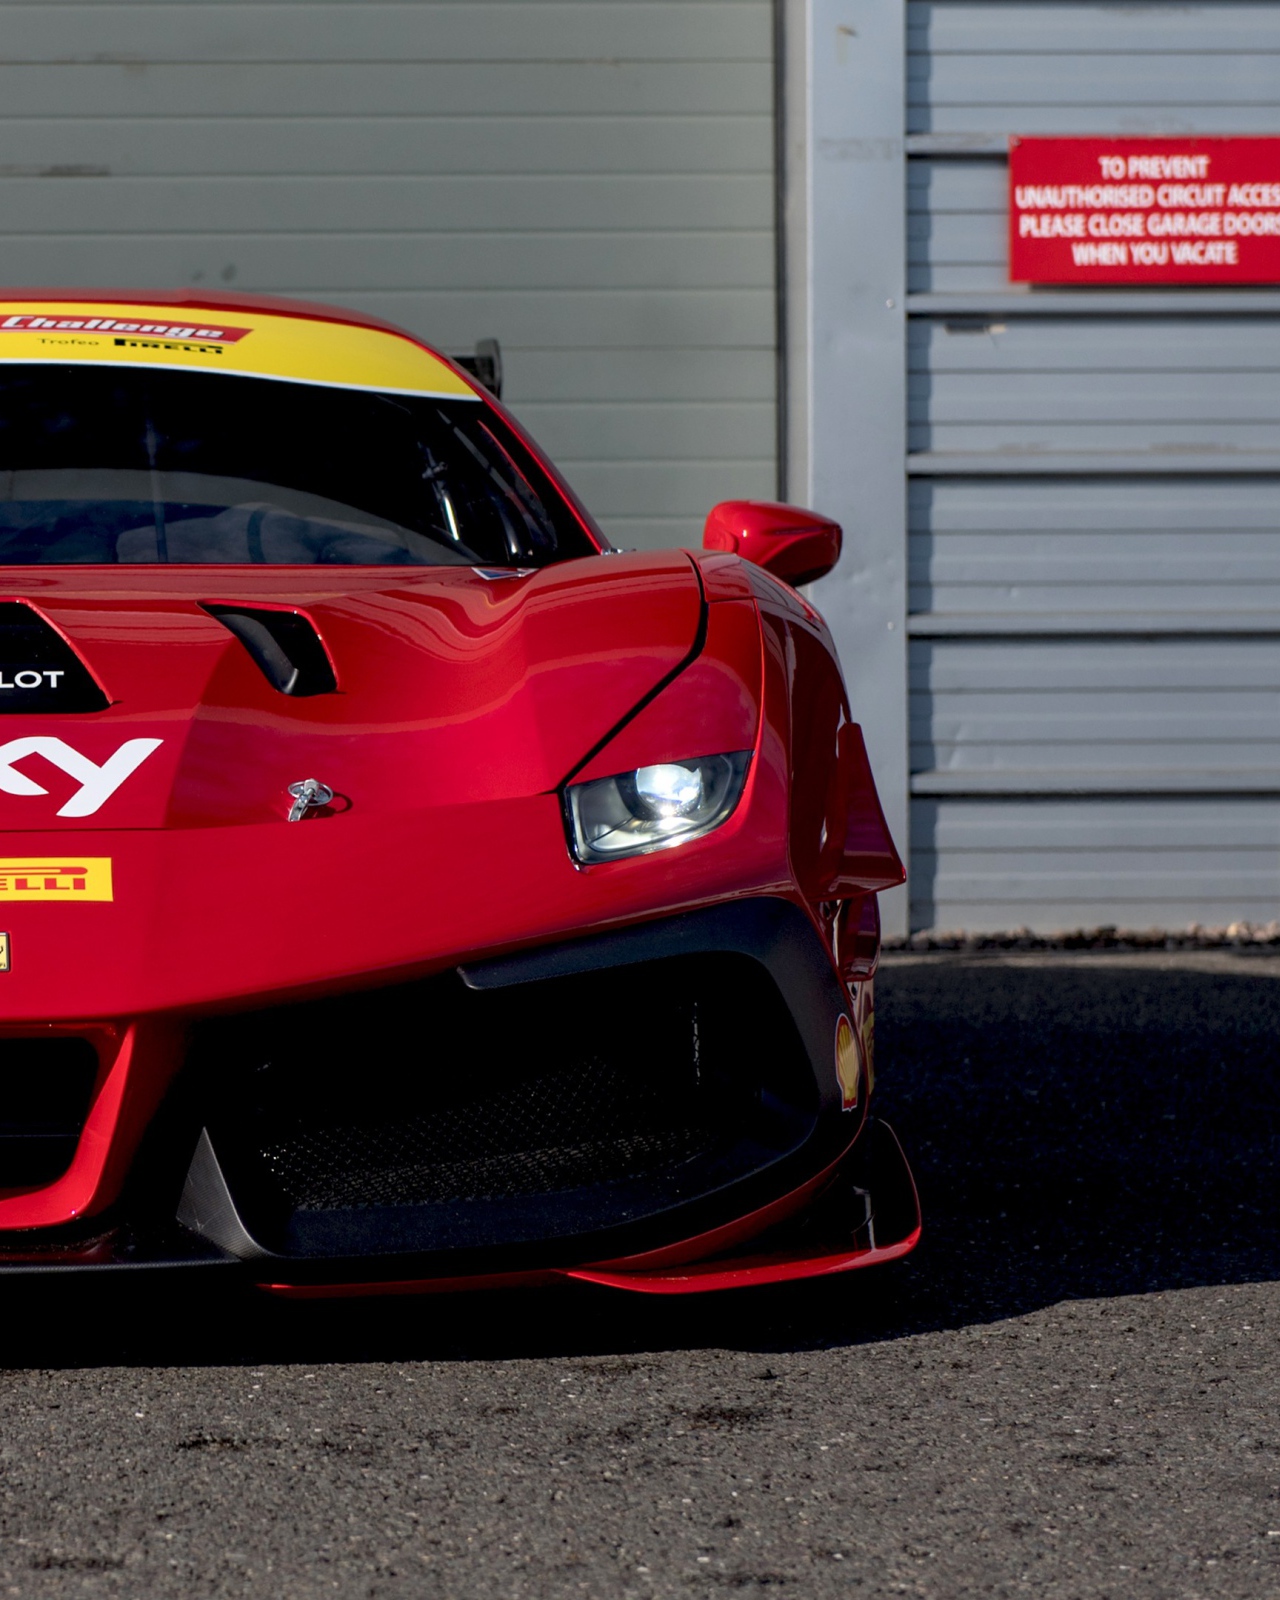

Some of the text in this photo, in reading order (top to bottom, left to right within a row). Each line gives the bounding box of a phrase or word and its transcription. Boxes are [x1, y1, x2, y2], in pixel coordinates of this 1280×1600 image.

[1098, 154, 1210, 180] TO PREVENT
[1015, 184, 1154, 209] UNAUTHORISED
[1157, 183, 1226, 208] CIRCUIT
[1019, 211, 1280, 238] PLEASE CLOSE GARAGE DOOR
[1071, 240, 1238, 266] WHEN YOU VACATE
[1, 315, 225, 338] Challenge
[38, 337, 224, 355] Trofeo PIRELLI
